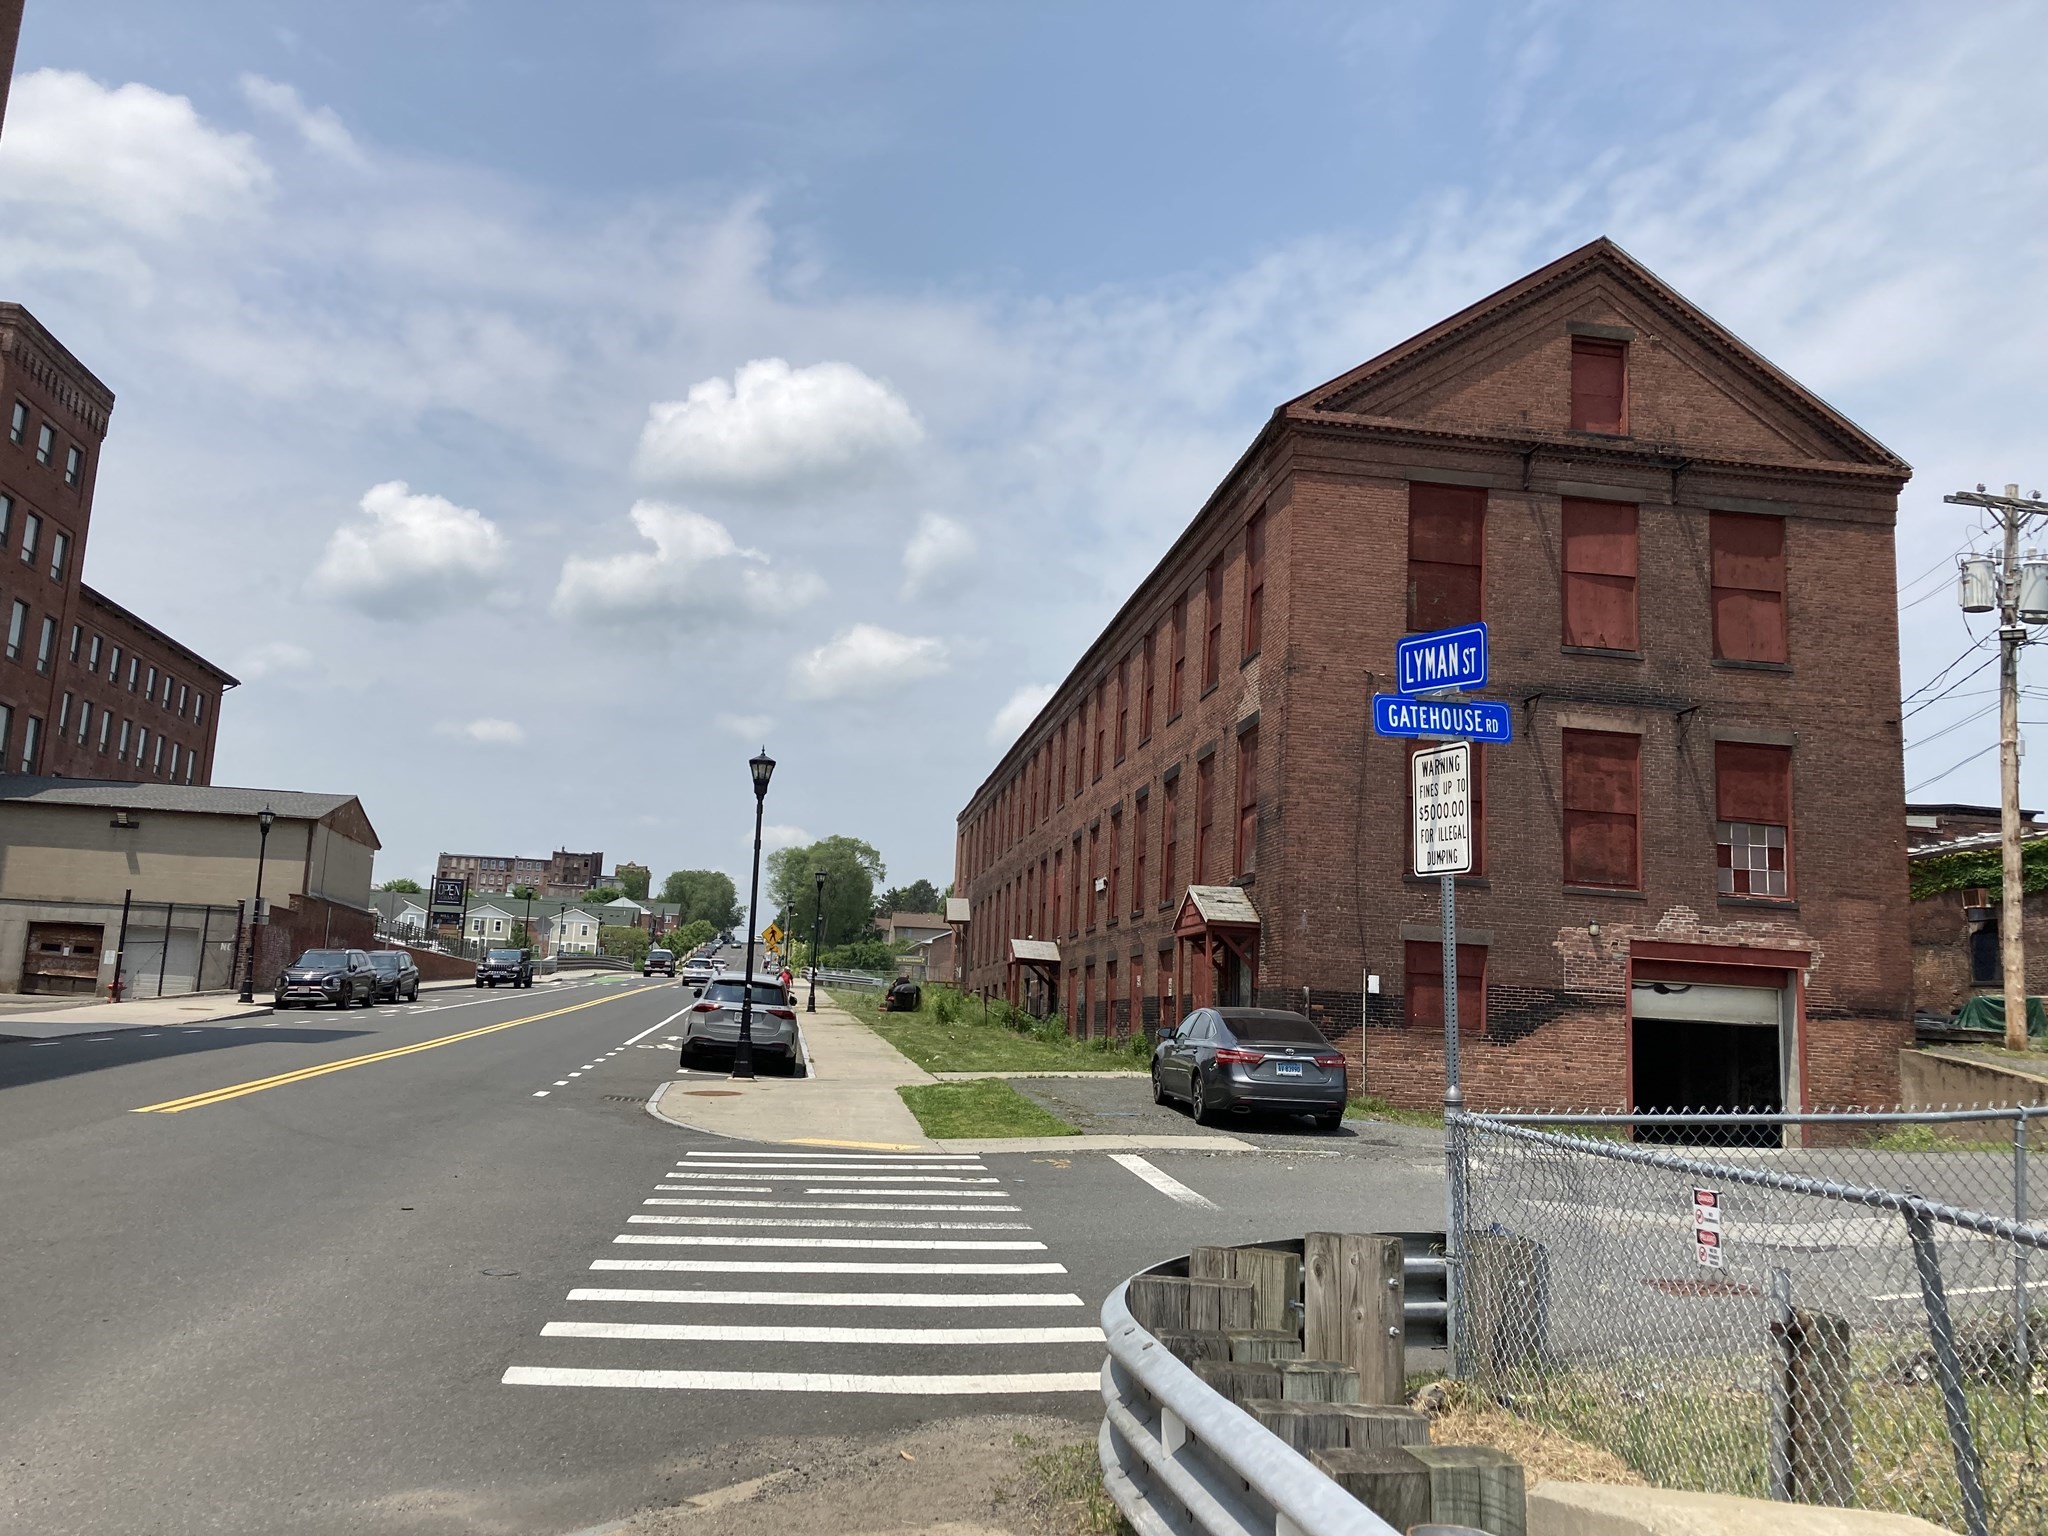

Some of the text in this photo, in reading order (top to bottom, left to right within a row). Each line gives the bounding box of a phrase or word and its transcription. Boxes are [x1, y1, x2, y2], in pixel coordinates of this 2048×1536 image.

[1405, 642, 1477, 684] LYMAN ST
[1388, 704, 1499, 733] GATEHOUSE RD
[1421, 754, 1460, 778] WARNING
[1419, 778, 1466, 799] FINES UP TO
[1419, 800, 1465, 821] $5000.00
[1420, 824, 1467, 844] FOR ILLEGAL
[1427, 848, 1458, 866] DUMPING
[438, 883, 461, 896] OPEN
